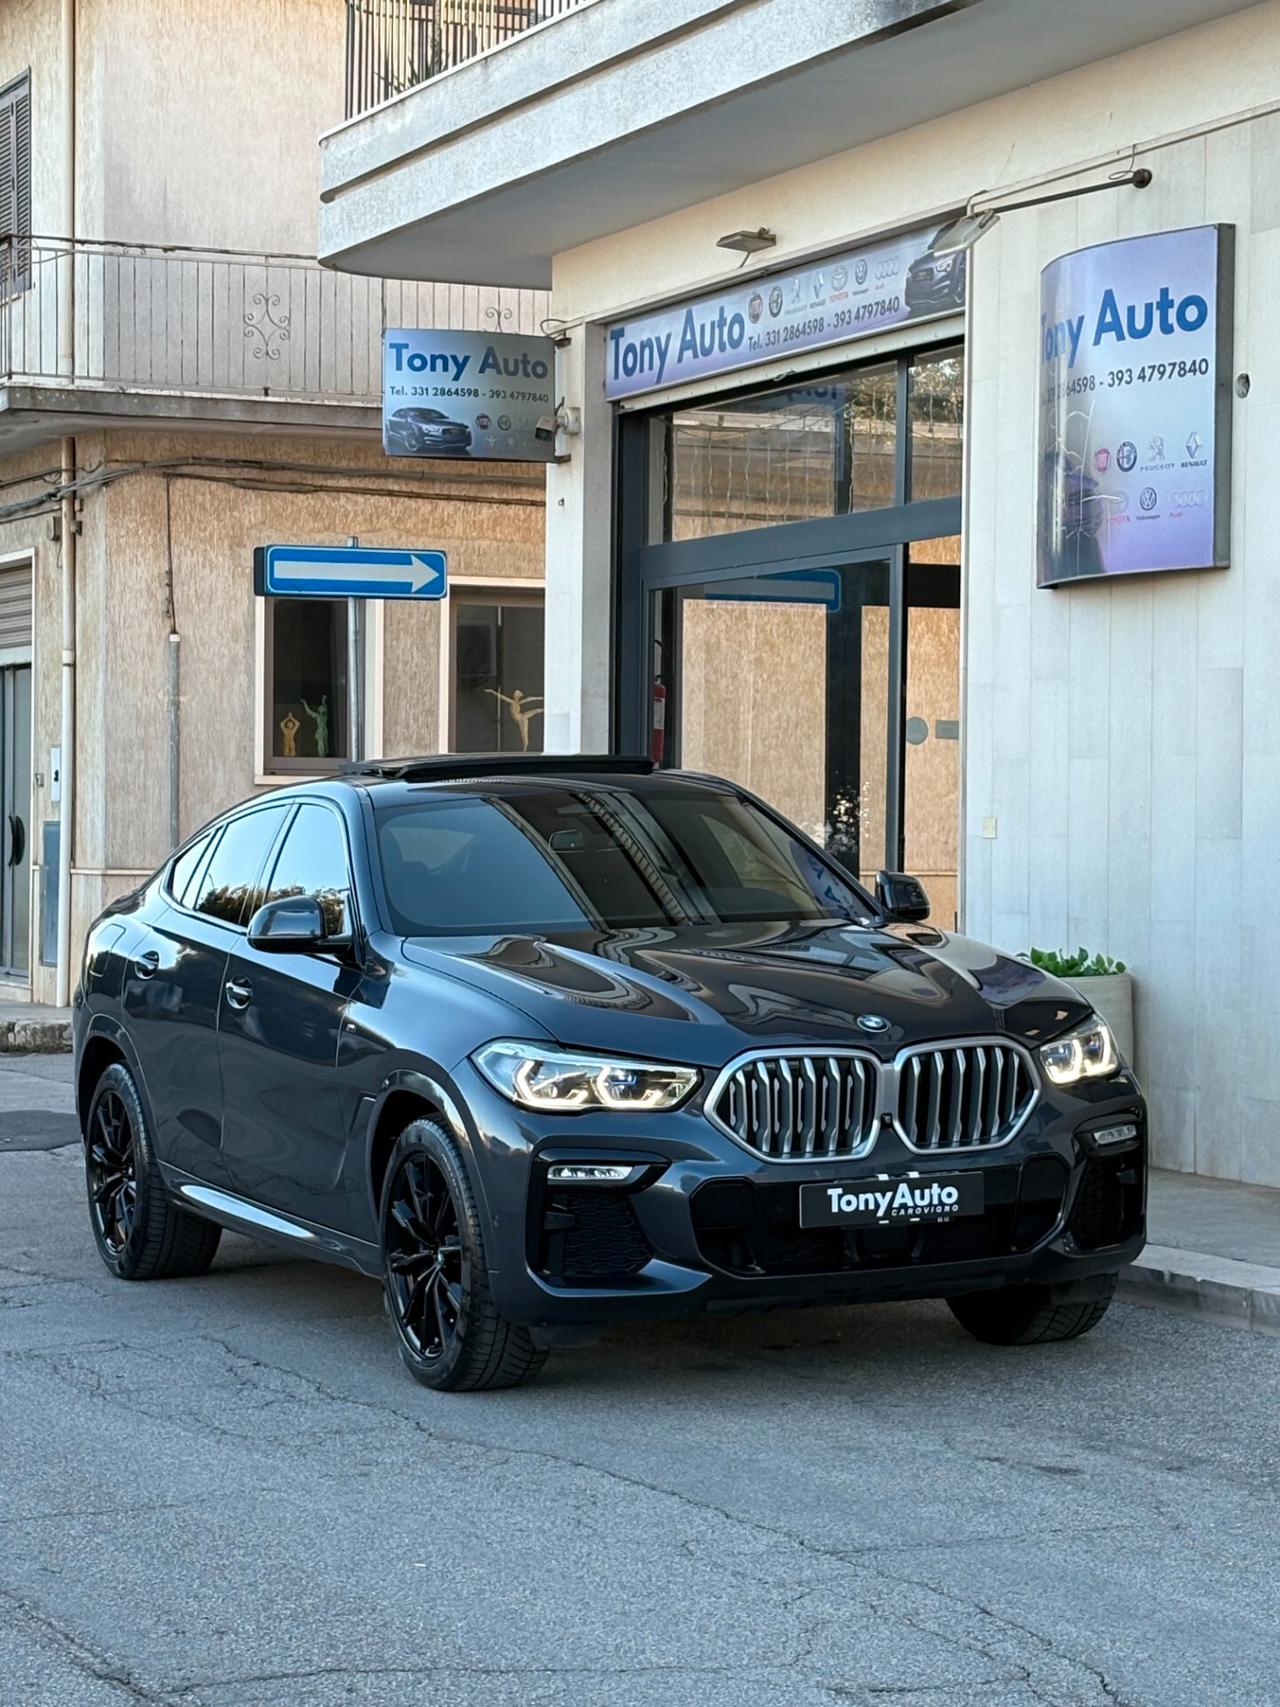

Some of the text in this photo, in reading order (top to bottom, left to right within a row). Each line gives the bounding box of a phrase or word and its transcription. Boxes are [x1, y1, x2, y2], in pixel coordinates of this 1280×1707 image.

[748, 336, 762, 351] Tel.
[765, 330, 780, 347] 331
[783, 317, 825, 343] 2864598
[833, 310, 851, 329] 393
[854, 295, 900, 321] 4797840
[1092, 287, 1209, 346] Auto
[389, 343, 549, 381] Tony Auto
[610, 306, 746, 383] Tony Auto
[1107, 368, 1133, 388] 393
[1137, 358, 1209, 383] 4797840
[390, 386, 408, 396] Tel.
[411, 386, 429, 397] 331
[432, 387, 479, 398] 2864598
[489, 389, 507, 399] 393
[509, 391, 549, 403] 4797840
[891, 1204, 959, 1216] CAROVIGNO
